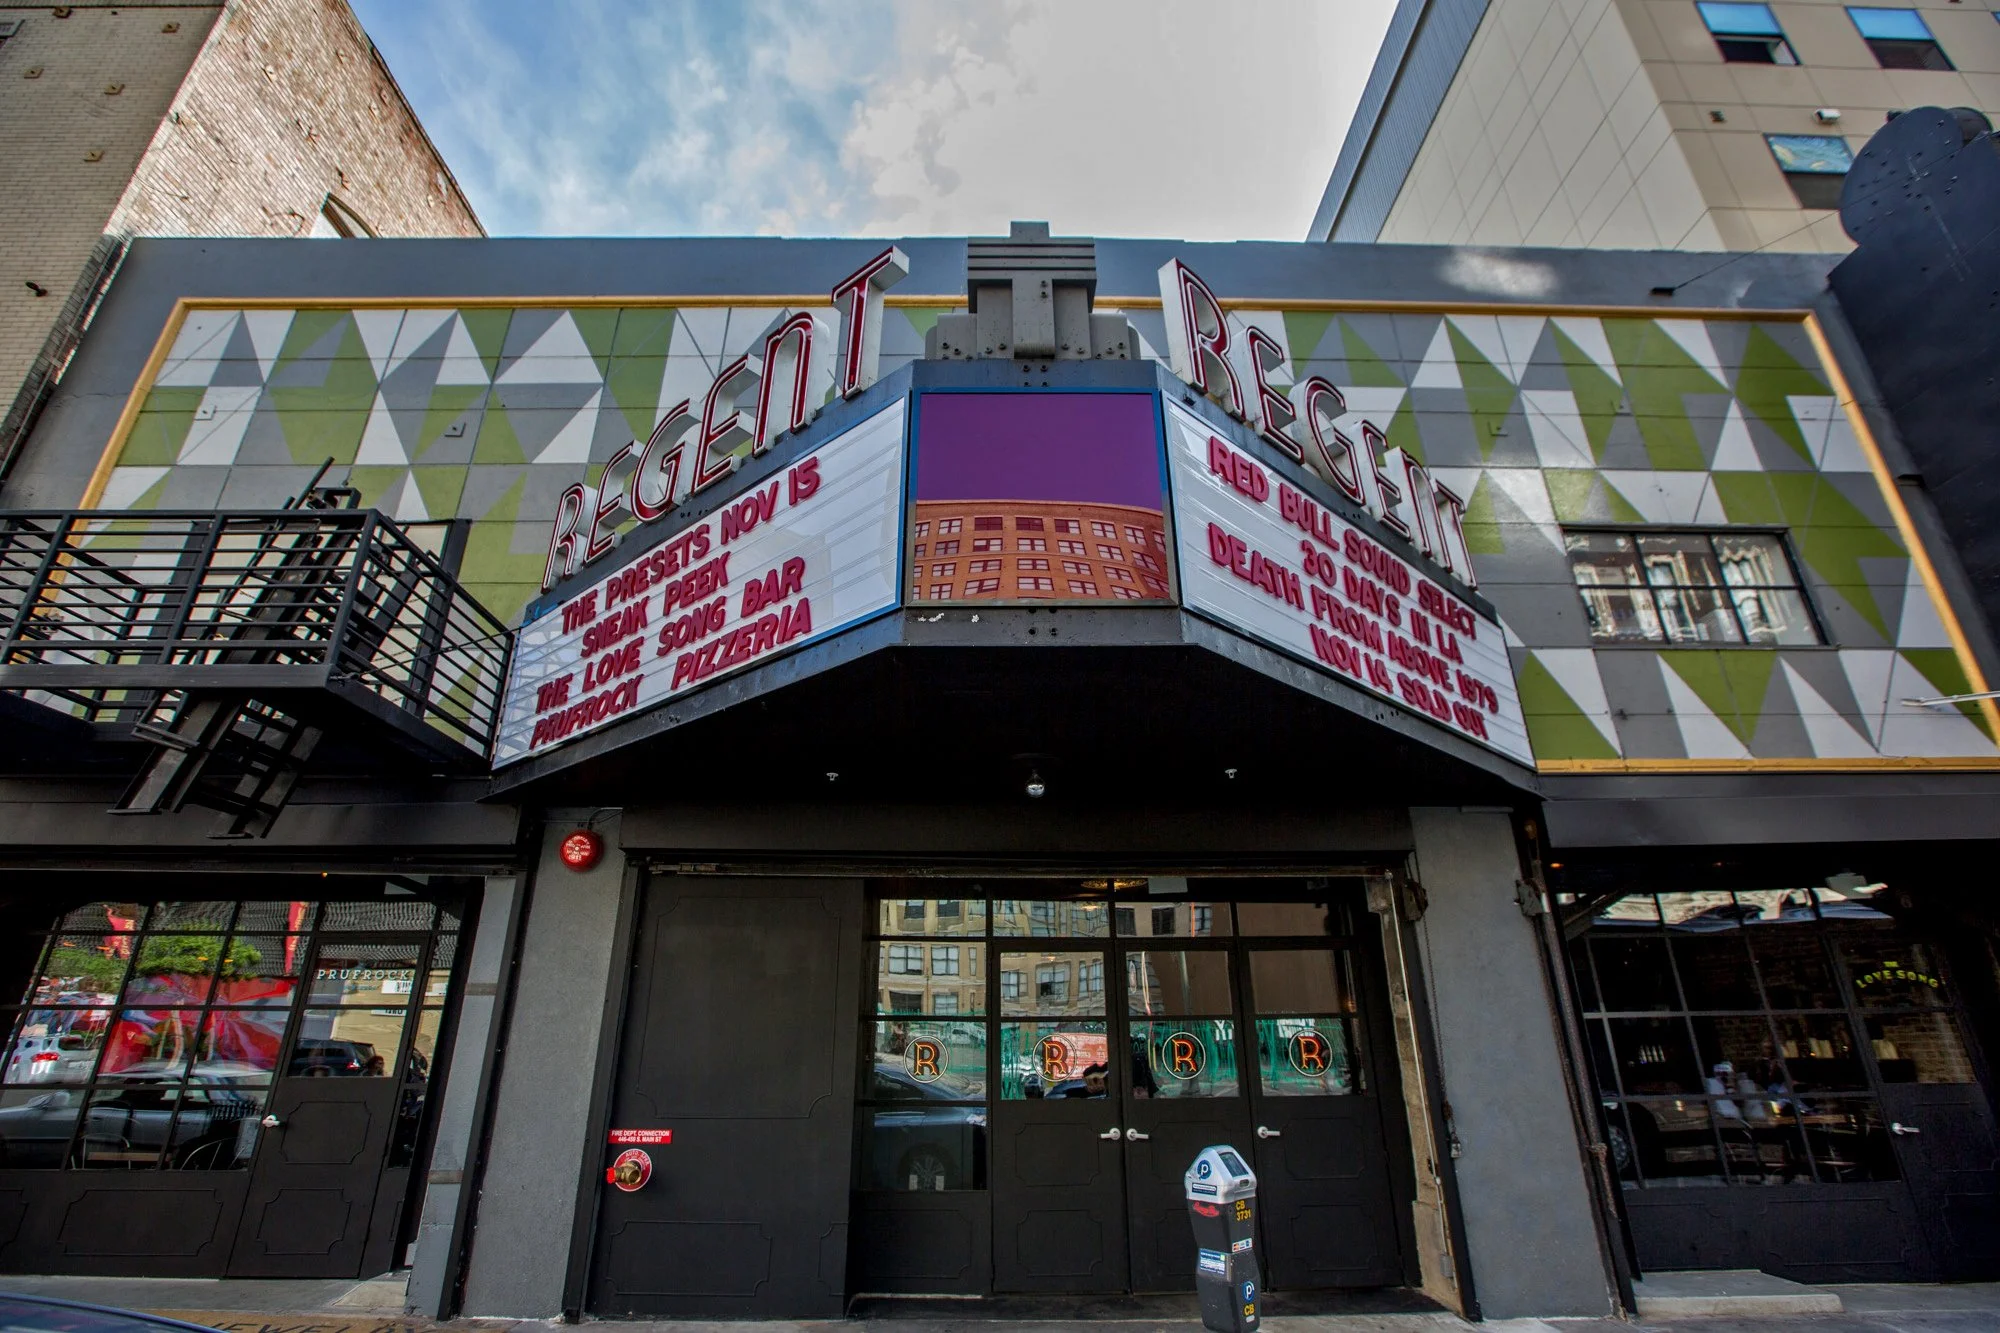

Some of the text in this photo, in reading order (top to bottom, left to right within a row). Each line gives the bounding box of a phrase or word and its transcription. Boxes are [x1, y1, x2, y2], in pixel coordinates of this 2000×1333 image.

[543, 245, 907, 594] REGENT
[1163, 257, 1479, 591] REGENT
[562, 456, 821, 635] THE PRESETS NOV 15
[1210, 436, 1477, 640] RED BULL SOUND SELECT
[535, 556, 806, 715] THE LOVE SONG BAR
[580, 551, 731, 658] SNEAK PEEK
[1208, 522, 1499, 714] DEATH FROM ABOVE 1979
[1301, 540, 1464, 664] 30 DAYS IN LA
[528, 597, 812, 749] PRUFROCK PIZZERIA
[1309, 623, 1490, 740] NOV 14 SOLD OUT
[316, 969, 411, 980] PRUFROCK
[1855, 970, 1938, 988] LOVE SONG
[913, 1041, 940, 1076] R
[1042, 1040, 1069, 1075] R
[1171, 1038, 1197, 1072] R
[1298, 1035, 1324, 1070] R
[1235, 1200, 1246, 1211] CB
[1236, 1208, 1252, 1221] 3731
[1243, 1303, 1255, 1316] CB
